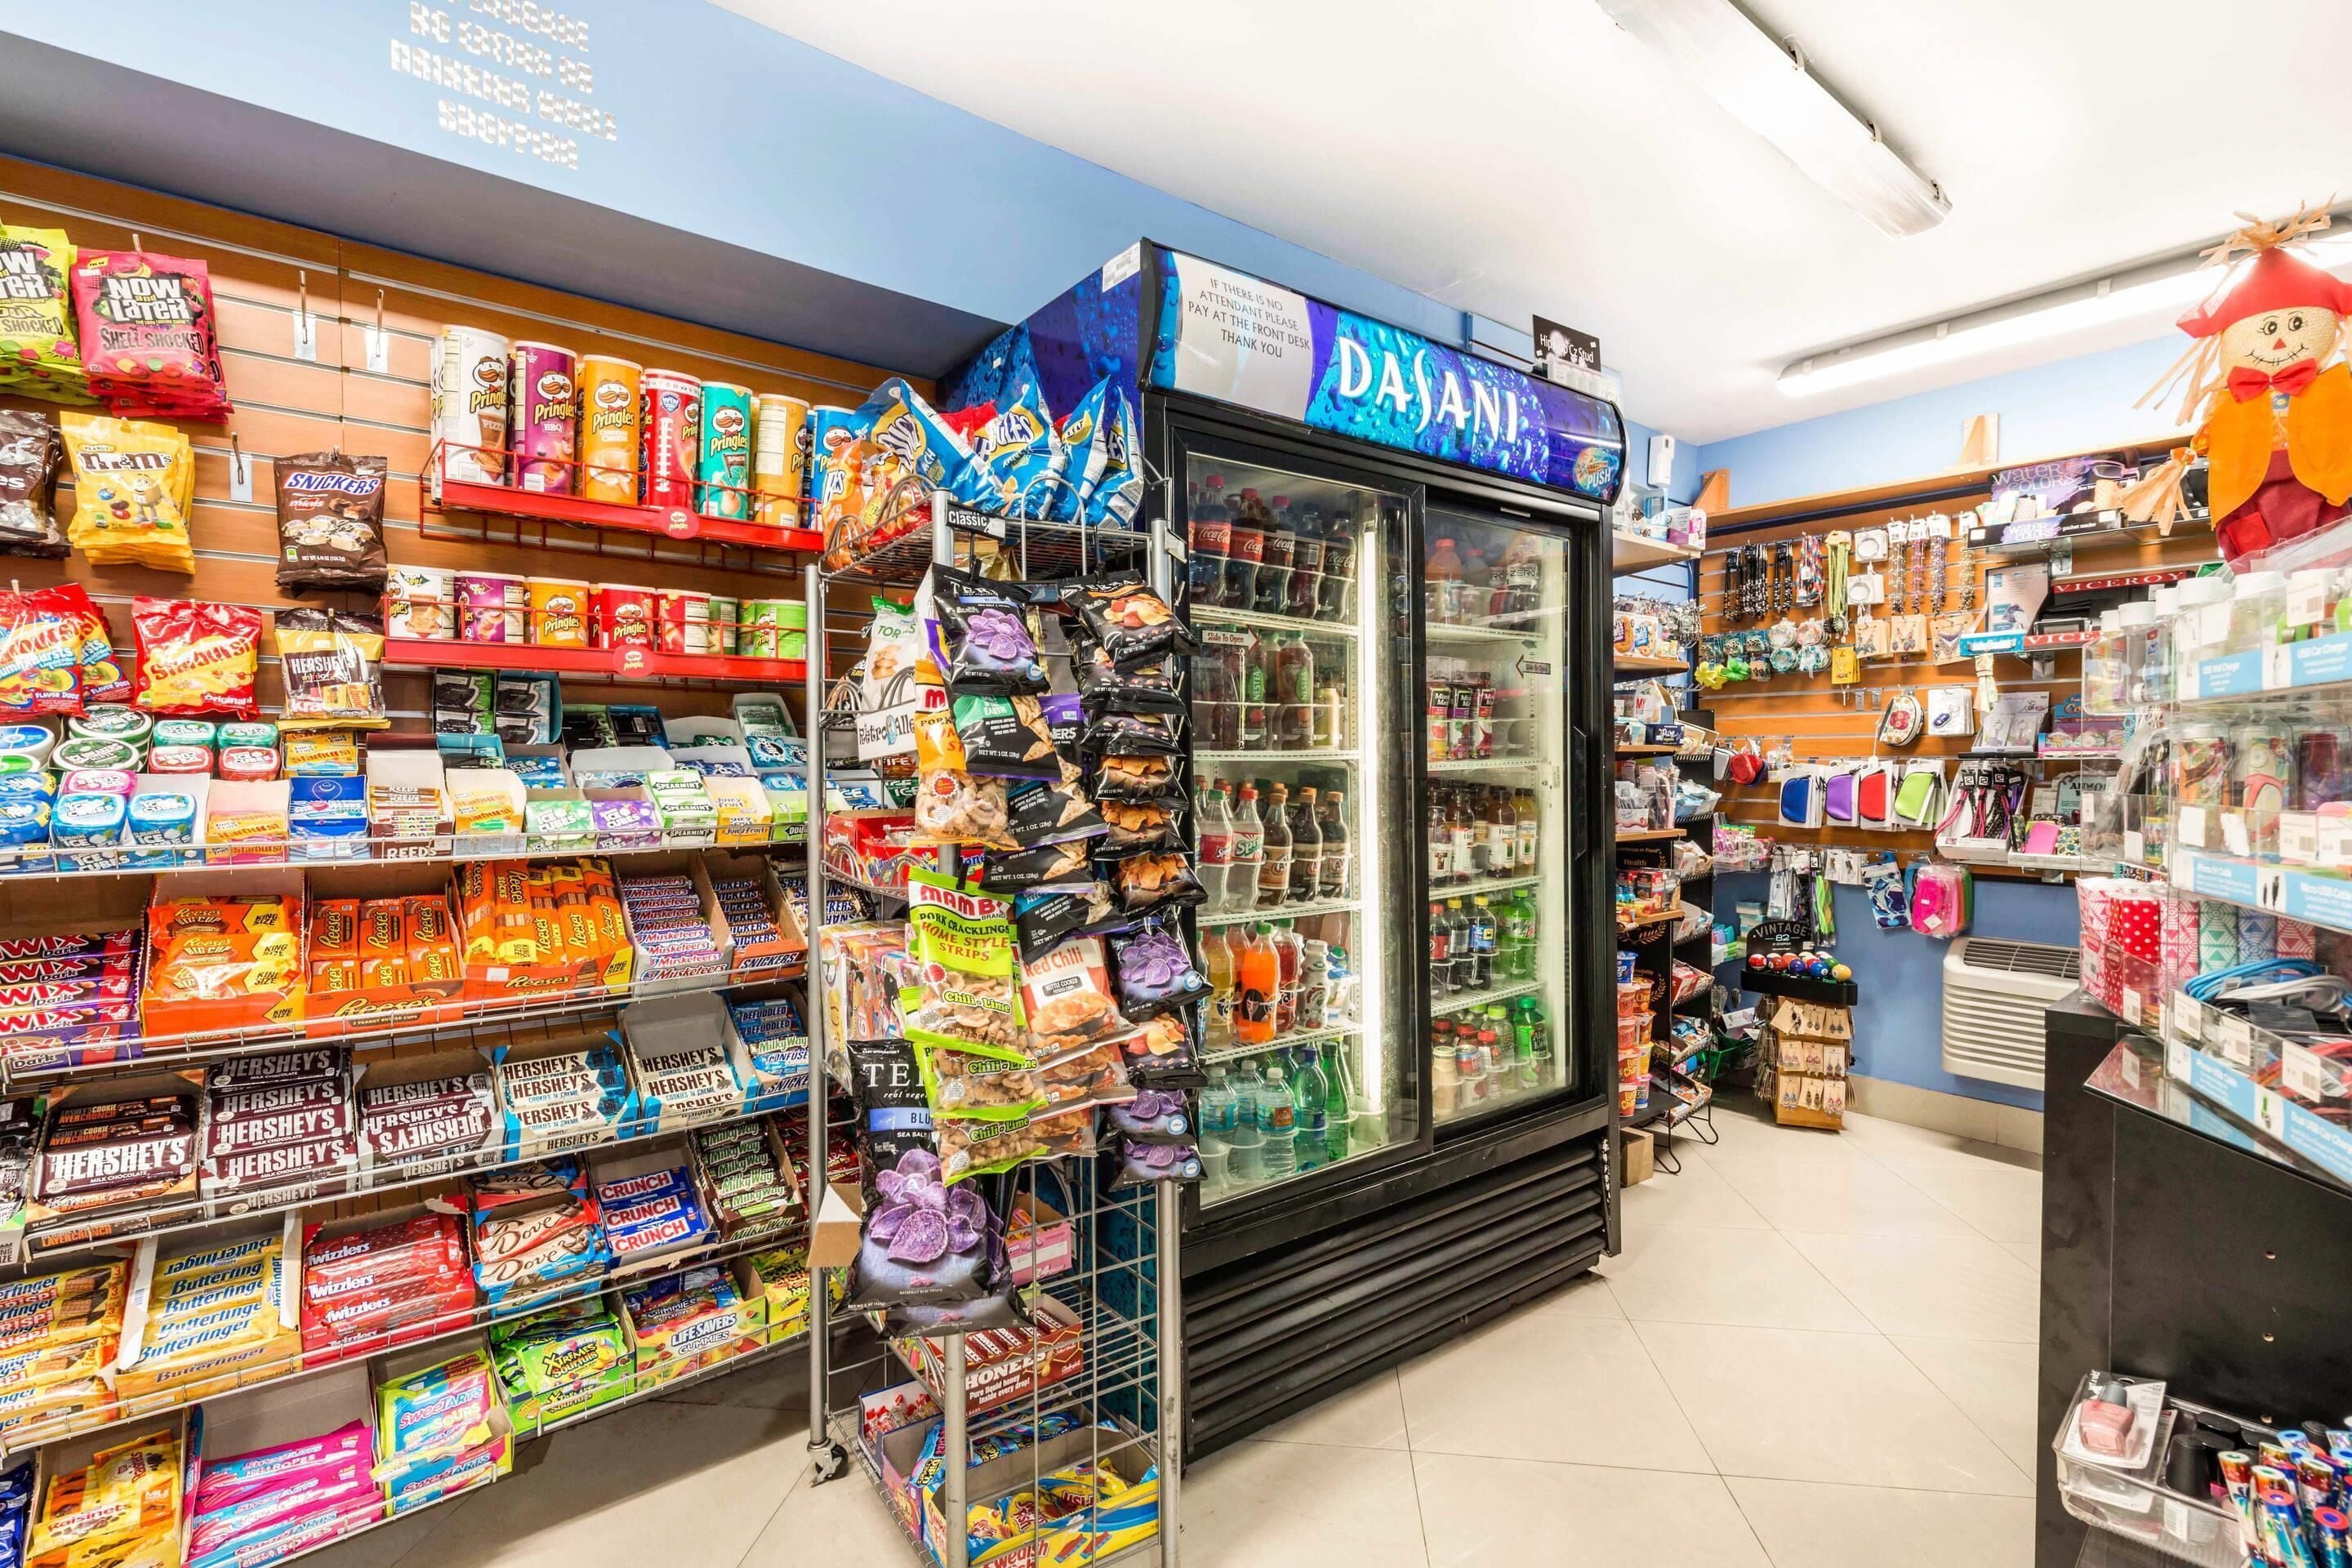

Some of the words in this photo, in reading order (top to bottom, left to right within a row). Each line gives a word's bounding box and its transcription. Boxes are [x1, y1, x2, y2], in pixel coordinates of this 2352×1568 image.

[411, 2, 449, 43] NO
[458, 20, 552, 79] EATING
[559, 56, 593, 94] OR
[391, 39, 530, 114] DRINKING
[537, 90, 617, 142] WHILE
[438, 99, 578, 171] SHOPPING
[106, 278, 182, 299] NOW
[136, 294, 158, 302] and
[1210, 278, 1219, 288] IF
[1222, 282, 1254, 301] THERE
[1256, 293, 1264, 305] IS
[1267, 298, 1282, 310] NO
[1200, 291, 1263, 318] ATTENDANT
[1265, 311, 1298, 331] PLEASE
[4, 317, 64, 336] SHOCKED
[1188, 301, 1208, 318] PAY
[1213, 311, 1227, 323] AT
[1230, 314, 1250, 331] THE
[1253, 323, 1285, 341] FRONT
[1288, 334, 1310, 350] DESK
[100, 327, 143, 352] SHELL
[145, 331, 204, 355] SHOCKED
[1221, 329, 1257, 351] THANK
[1261, 340, 1282, 358] YOU
[1540, 334, 1552, 350] Hip
[1569, 345, 1578, 357] Cz
[1579, 347, 1593, 363] Stud
[1339, 336, 1517, 444] DASANI
[534, 399, 575, 425] Pringles
[592, 408, 635, 434] Pringles
[544, 423, 563, 432] BBQ
[710, 434, 747, 457] Pringles
[286, 473, 381, 495] SNICKERS
[289, 499, 325, 508] minis
[949, 511, 987, 526] Classic
[2054, 572, 2186, 594] VICEROY
[544, 617, 580, 636] Pringles
[613, 624, 647, 641] Pringles
[1207, 632, 1222, 641] Slide
[1223, 634, 1228, 642] To
[1229, 635, 1245, 643] Open
[2026, 630, 2100, 645] VICE
[90, 682, 114, 694] FLAVOR
[983, 706, 1006, 716] EARTH
[896, 715, 915, 734] Alle
[656, 782, 702, 790] SPEARMINT
[666, 804, 711, 813] SPEARMINT
[508, 871, 528, 905] Reese's
[626, 878, 682, 887] Musketeers
[197, 915, 222, 924] CUP
[318, 911, 341, 948] Reese's
[368, 911, 389, 949] Reese's
[413, 906, 433, 943] Reese's
[644, 920, 700, 931] Musketeers
[920, 913, 947, 925] PORK
[948, 920, 1009, 935] CRACKLINGS
[1756, 923, 1807, 938] VINTAGE
[647, 930, 704, 941] Musketeers
[922, 921, 958, 943] HOME
[964, 937, 1009, 947] STYLE
[0, 934, 88, 959] WIX
[43, 944, 79, 959] Dark
[939, 942, 990, 961] STRIPS
[609, 960, 628, 969] KING
[739, 954, 799, 969] SNICKERS
[1024, 960, 1051, 978] Red
[1053, 946, 1084, 969] Chili
[41, 968, 78, 982] Dark
[1061, 977, 1079, 987] COOKED
[742, 1005, 789, 1022] BEFUDDLED
[944, 991, 976, 1006] Chili
[981, 996, 1011, 1013] Lime
[744, 1020, 791, 1036] BEFUDDLED
[222, 1049, 331, 1076] HERSHEY'S
[969, 1061, 1000, 1074] Chili
[224, 1080, 335, 1113] HERSHEY'S
[371, 1076, 464, 1105] HERSHEY'S
[512, 1073, 590, 1099] HERSHEY'S
[884, 1090, 902, 1098] real
[92, 1103, 117, 1113] COOKIE
[519, 1095, 546, 1104] COOKIES
[220, 1108, 336, 1147] HERSHEY'S
[53, 1138, 185, 1181] HERSHEY'S
[229, 1139, 345, 1178] HERSHEY'S
[90, 1175, 107, 1184] MILK
[108, 1169, 149, 1183] CHOCOLATE
[599, 1173, 670, 1200] CRUNCH
[607, 1197, 678, 1225] CRUNCH
[485, 1215, 561, 1254] Dove
[614, 1222, 687, 1251] CRUNCH
[308, 1241, 371, 1267] Twizzlers
[308, 1274, 374, 1299] Twizzlers
[139, 1320, 251, 1363] Butterfinger
[679, 1331, 729, 1355] GUMMIES
[156, 1347, 267, 1383] Butterfinger
[965, 1351, 1046, 1390] HONEES
[969, 1388, 985, 1400] Pure
[986, 1383, 1001, 1395] liquid
[1002, 1374, 1020, 1388] honey
[978, 1390, 996, 1404] inside
[997, 1386, 1014, 1399] every
[1015, 1378, 1031, 1391] drop!
[47, 1502, 131, 1533] Raisinets
